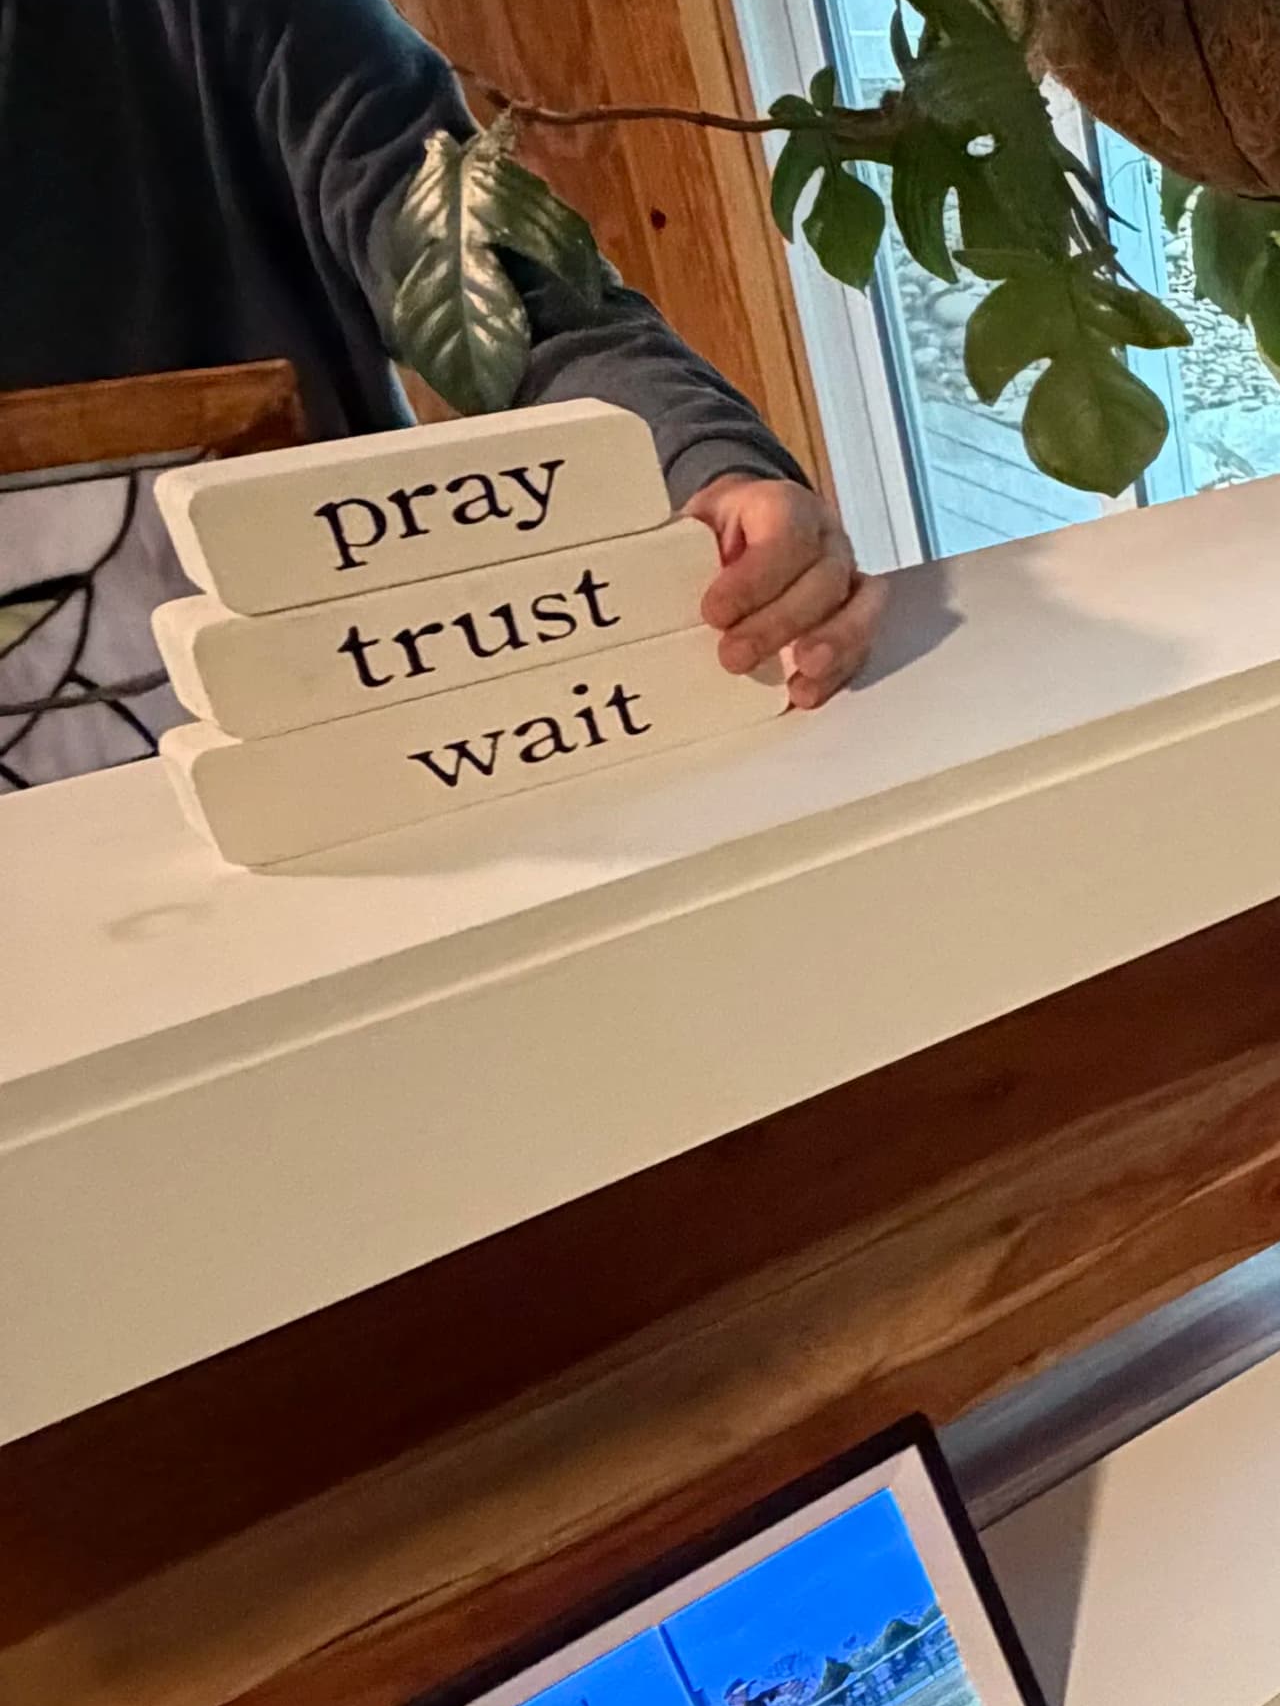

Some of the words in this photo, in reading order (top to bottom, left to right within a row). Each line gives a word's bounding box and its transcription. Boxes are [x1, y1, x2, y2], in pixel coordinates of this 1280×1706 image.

[312, 458, 566, 572] pray
[336, 568, 622, 689] trust
[406, 682, 653, 788] wait
